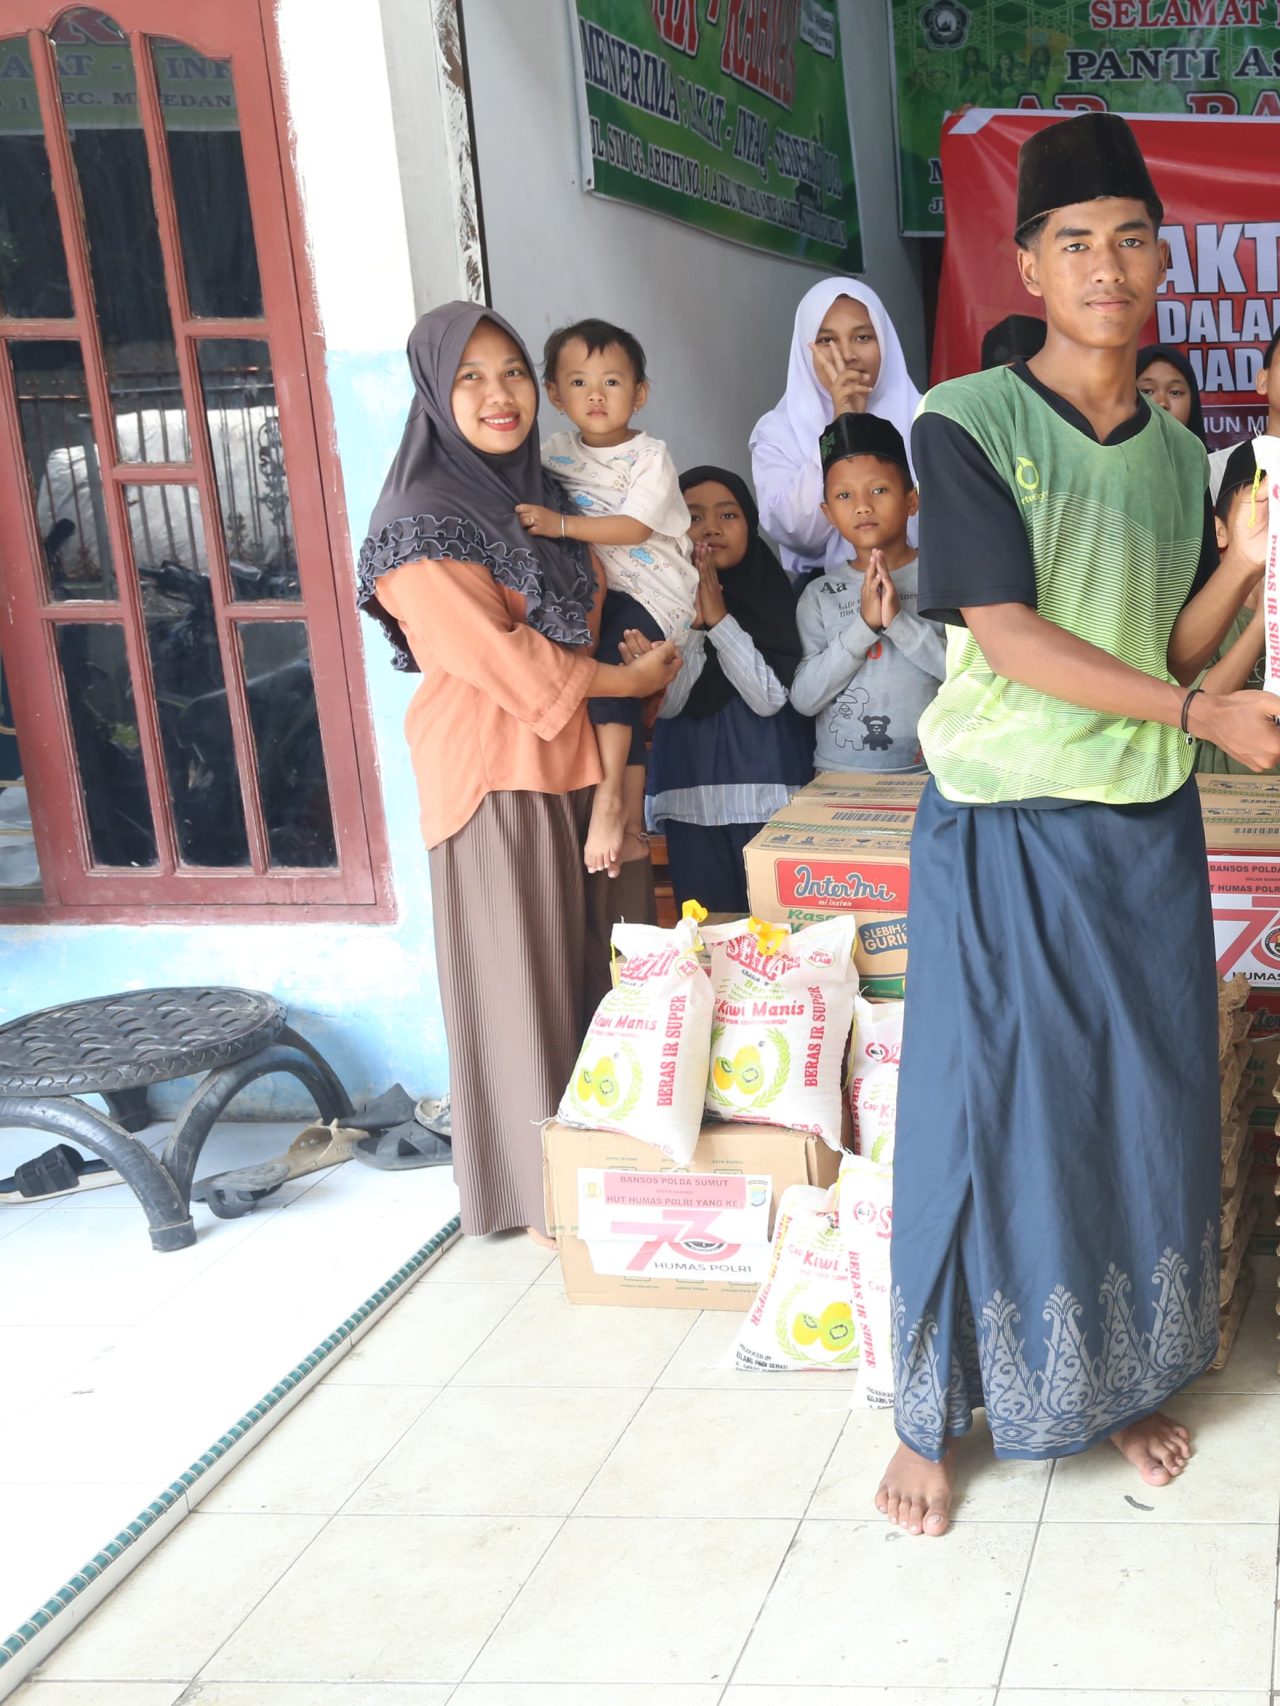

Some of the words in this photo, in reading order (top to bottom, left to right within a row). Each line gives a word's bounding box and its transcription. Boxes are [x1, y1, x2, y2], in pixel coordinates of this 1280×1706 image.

[1090, 0, 1265, 29] SELAMAT
[1066, 49, 1219, 80] PANTI
[820, 581, 848, 594] Aa
[839, 601, 855, 609] Life
[1267, 596, 1278, 616] IR
[1210, 865, 1249, 873] BANSOS
[871, 924, 902, 939] LEBIH
[717, 1000, 746, 1017] Kiwi
[752, 999, 805, 1017] Manis
[807, 985, 827, 1022] SUPER
[615, 1014, 658, 1031] Manis
[667, 995, 687, 1041] SUPER
[809, 1023, 825, 1041] IR
[662, 1042, 679, 1062] IR
[804, 1044, 822, 1088] BERAS
[656, 1063, 675, 1107] BERAS
[620, 1175, 659, 1185] BANSOS
[661, 1177, 692, 1186] POLDA
[695, 1178, 729, 1187] SUMUT
[606, 1196, 625, 1204] HUT
[629, 1197, 662, 1206] HUMAS
[664, 1198, 693, 1206] POLRI
[696, 1199, 722, 1207] YANG
[610, 1209, 742, 1272] 73
[654, 1261, 706, 1271] HUMAS
[710, 1264, 752, 1274] POLRI
[804, 1250, 839, 1271] Kiwi
[849, 1250, 864, 1302] BERAS
